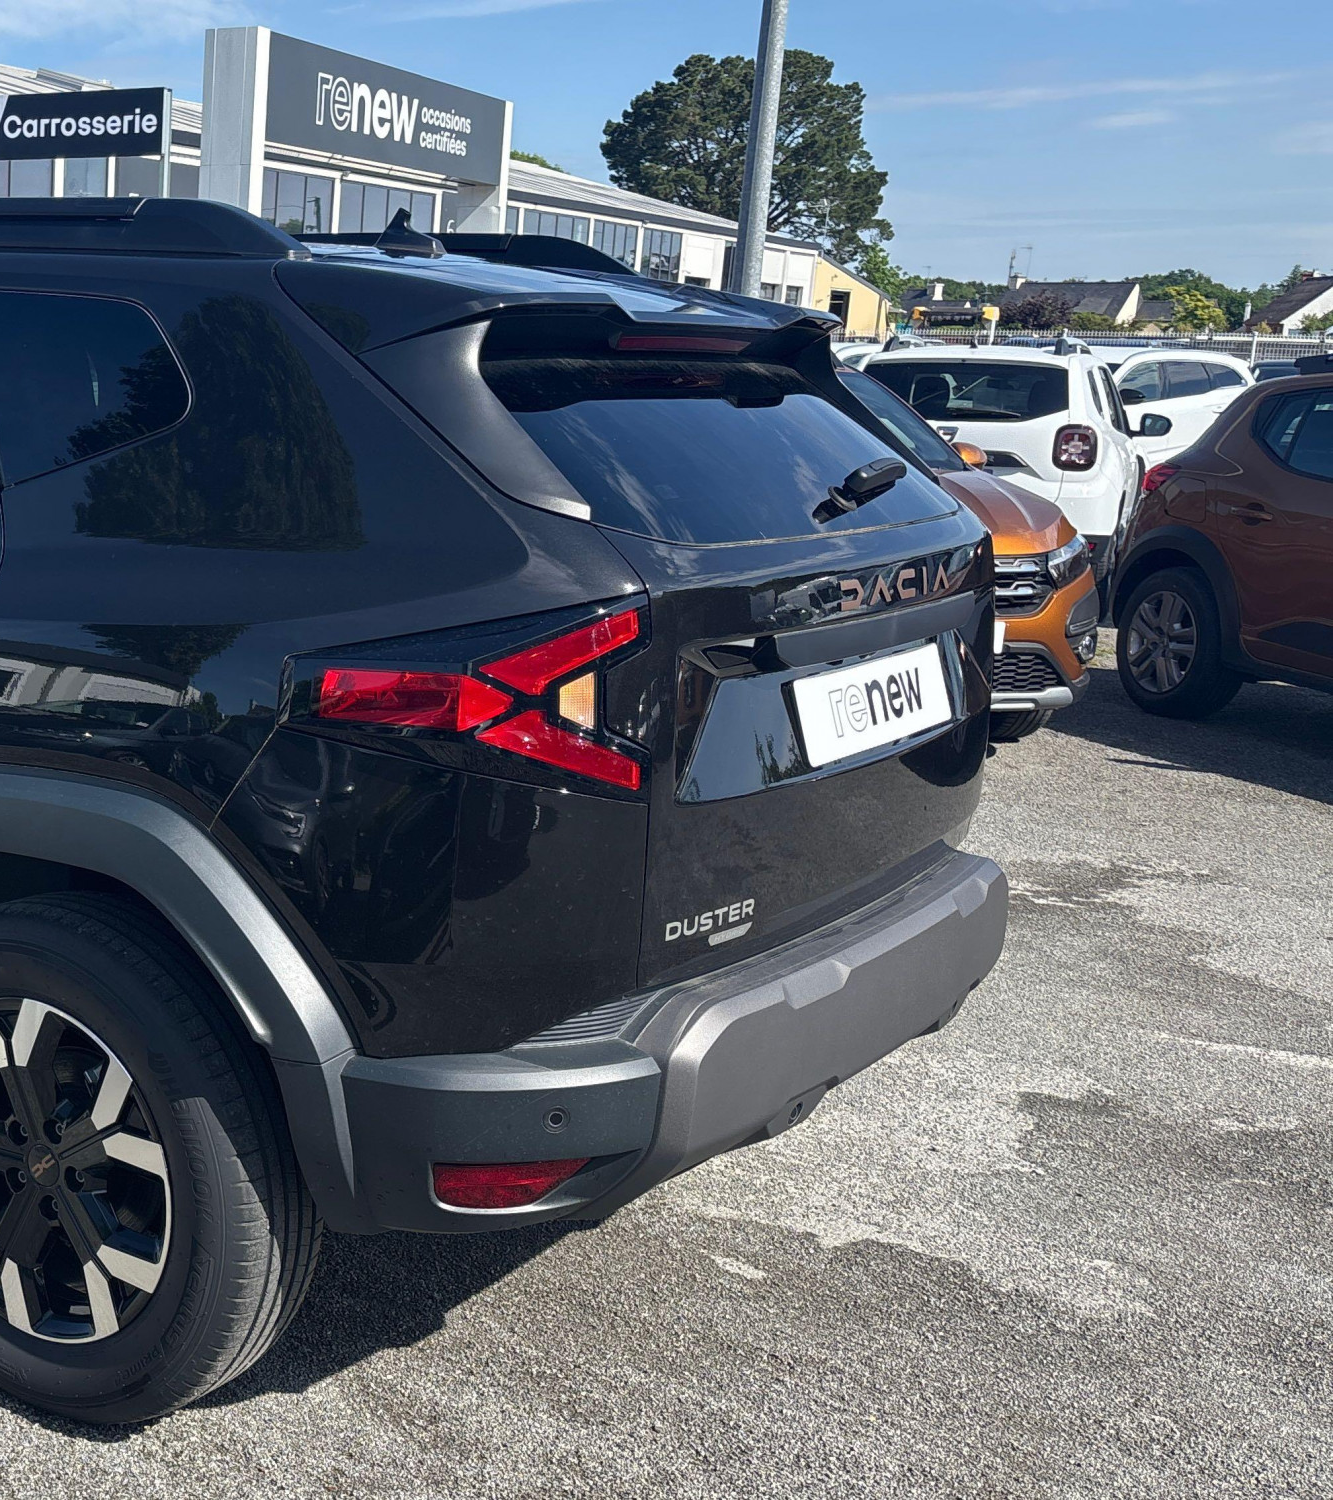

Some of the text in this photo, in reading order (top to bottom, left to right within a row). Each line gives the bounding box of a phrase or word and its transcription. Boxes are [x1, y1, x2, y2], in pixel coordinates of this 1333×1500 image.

[2, 108, 158, 139] Carrosserie
[315, 71, 419, 145] renew
[421, 106, 472, 134] occasions
[419, 130, 467, 157] certifiées
[839, 562, 950, 612] DACIA
[828, 667, 923, 738] renew
[664, 898, 755, 942] DUSTER
